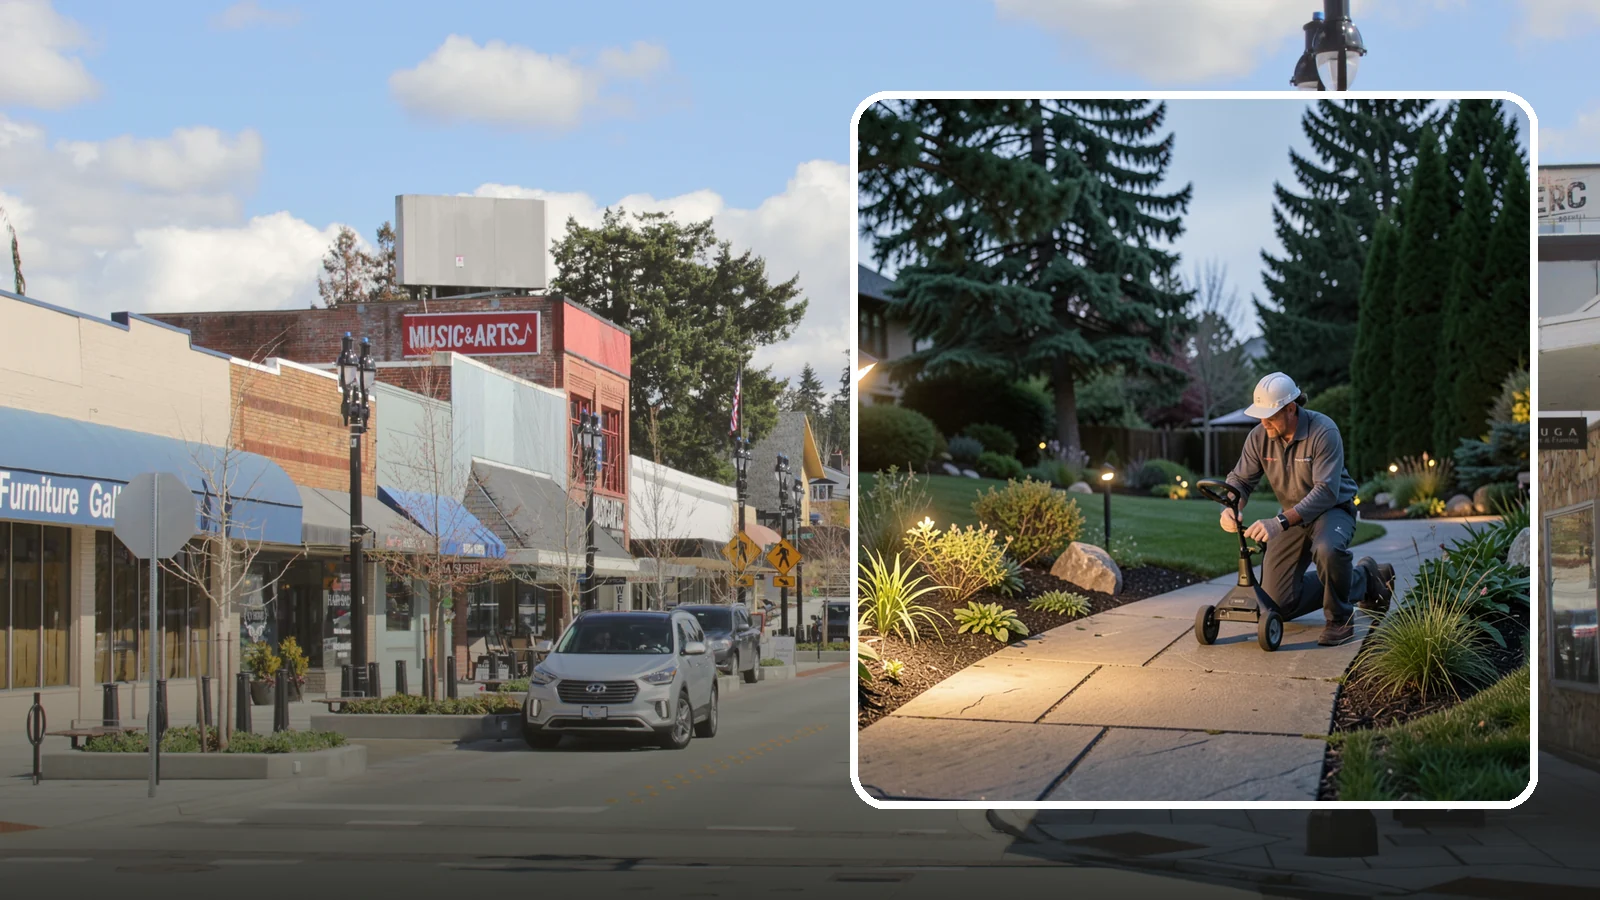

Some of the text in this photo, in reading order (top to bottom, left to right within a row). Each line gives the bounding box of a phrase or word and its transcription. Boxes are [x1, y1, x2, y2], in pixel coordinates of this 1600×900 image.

[409, 323, 519, 349] MUSIC&ARTS
[0, 472, 79, 516] Furniture
[453, 563, 479, 574] SUSHI
